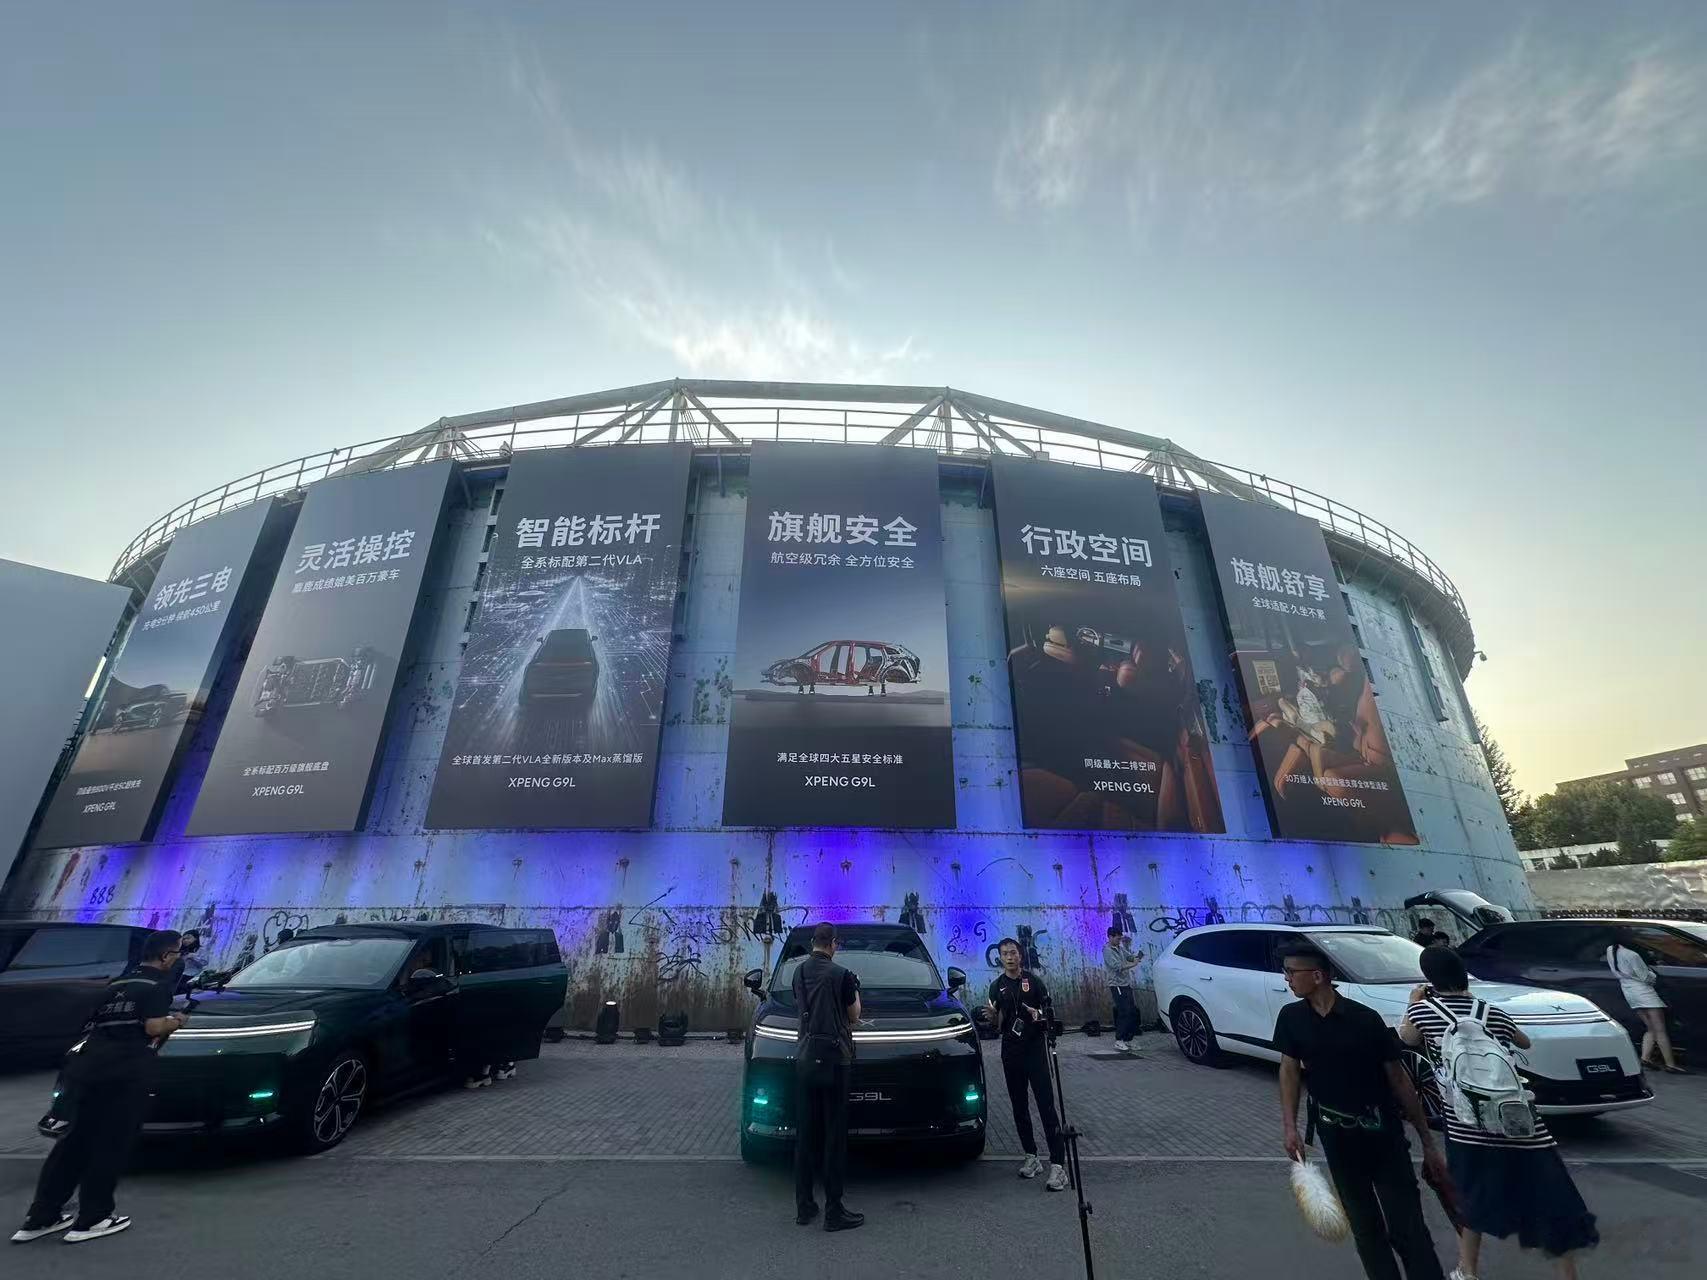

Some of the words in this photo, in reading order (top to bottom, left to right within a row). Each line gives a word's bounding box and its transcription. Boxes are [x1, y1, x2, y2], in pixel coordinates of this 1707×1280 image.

[516, 513, 661, 548] 智能标杆
[768, 511, 918, 547] 旗舰安全
[295, 529, 416, 574] 灵活操控
[1021, 524, 1153, 568] 行政空间
[521, 554, 643, 569] 全系标配第二代VLA
[770, 551, 841, 566] 航空级冗余
[845, 554, 914, 569] 全方位安全
[1041, 565, 1090, 581] 六座空间
[1094, 571, 1141, 587] 五座布局
[1230, 557, 1330, 601] 旗舰舒享
[153, 566, 232, 611] 领先三电
[777, 752, 903, 764] 满足全球四大五星安全标准
[1084, 758, 1156, 772] 同级最大二排空间
[508, 777, 550, 788] XPENG
[552, 777, 576, 788] G9L
[804, 776, 849, 787] XPENG
[851, 776, 876, 787] G9L
[1093, 780, 1131, 792] XPENG
[1133, 782, 1155, 793] G9L
[252, 785, 285, 797] XPENG
[286, 784, 304, 795] G9L
[1321, 796, 1349, 807] XPENG
[1350, 798, 1366, 808] G9L
[1586, 1064, 1617, 1073] G9L
